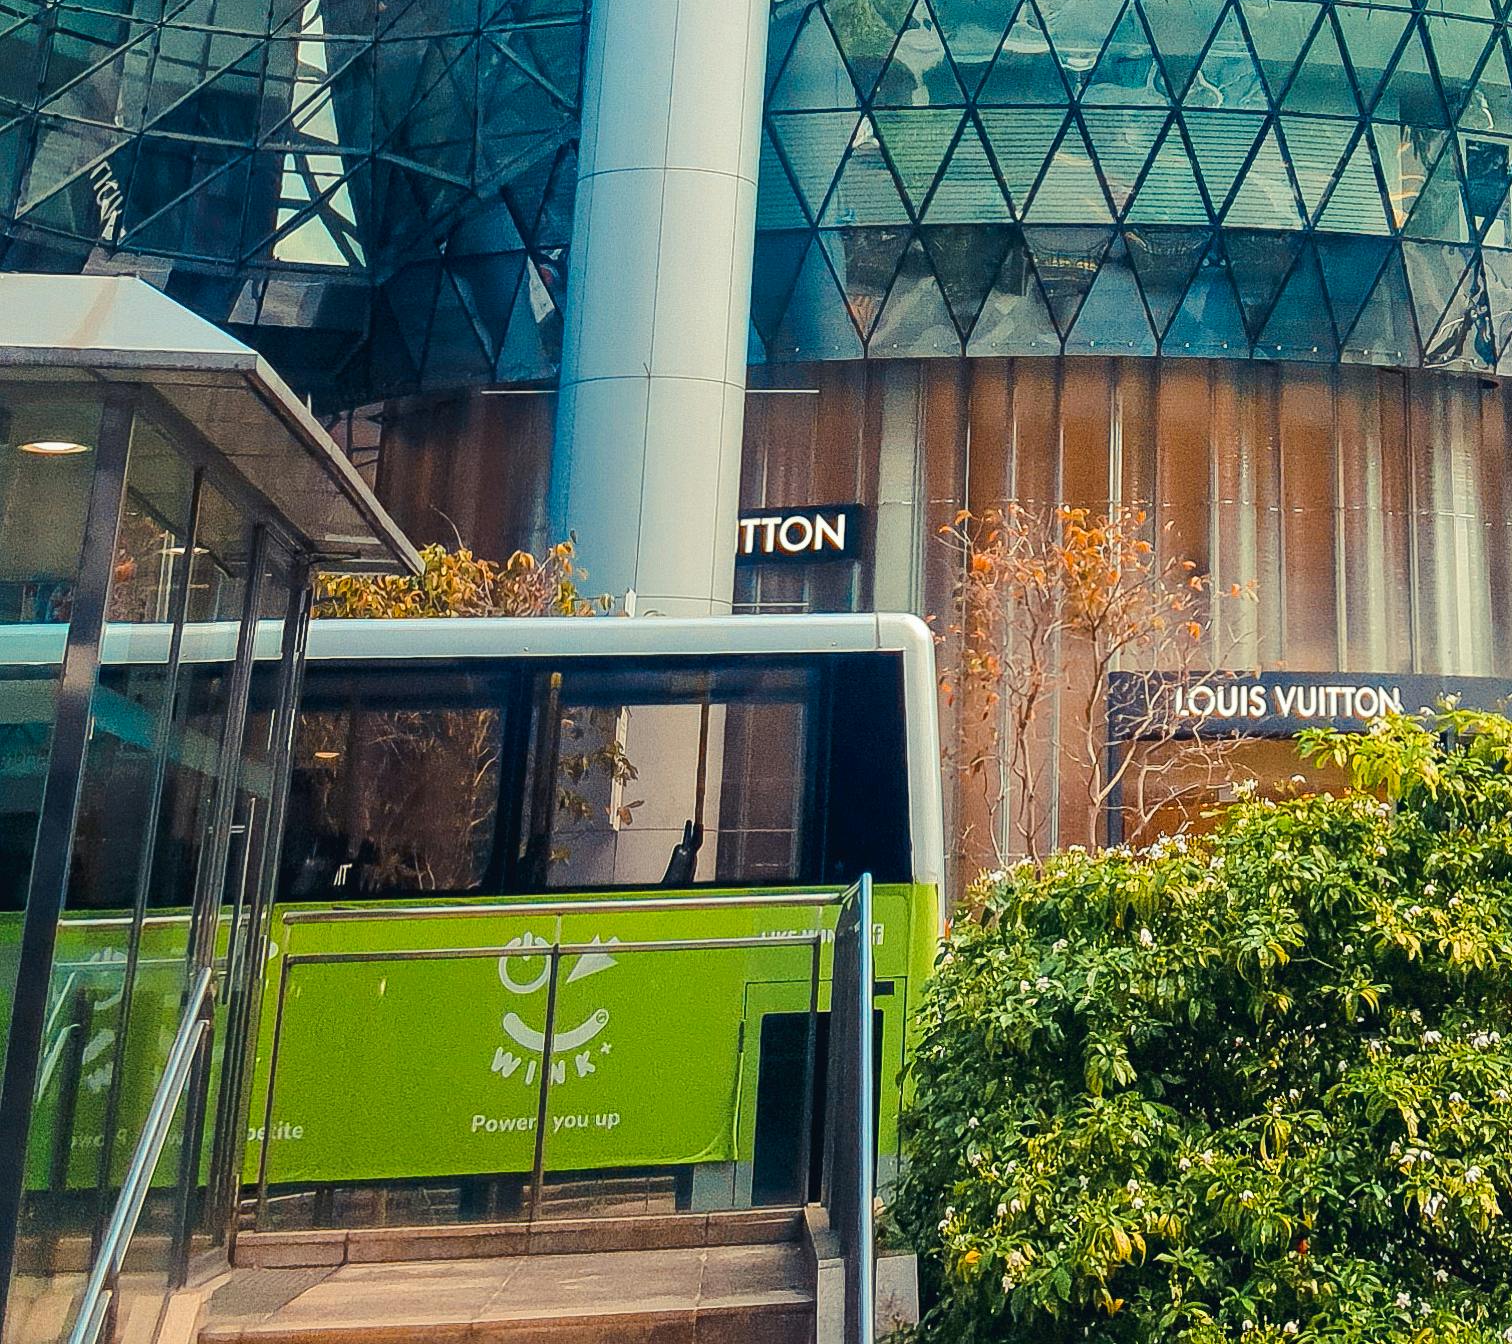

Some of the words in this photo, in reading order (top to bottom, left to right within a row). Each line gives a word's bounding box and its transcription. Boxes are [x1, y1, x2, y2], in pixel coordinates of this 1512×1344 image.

[1175, 685, 1267, 717] LOUIS
[1275, 685, 1404, 717] VUITTON
[472, 1114, 536, 1133] Power
[553, 1114, 589, 1133] you
[595, 1112, 621, 1129] up
